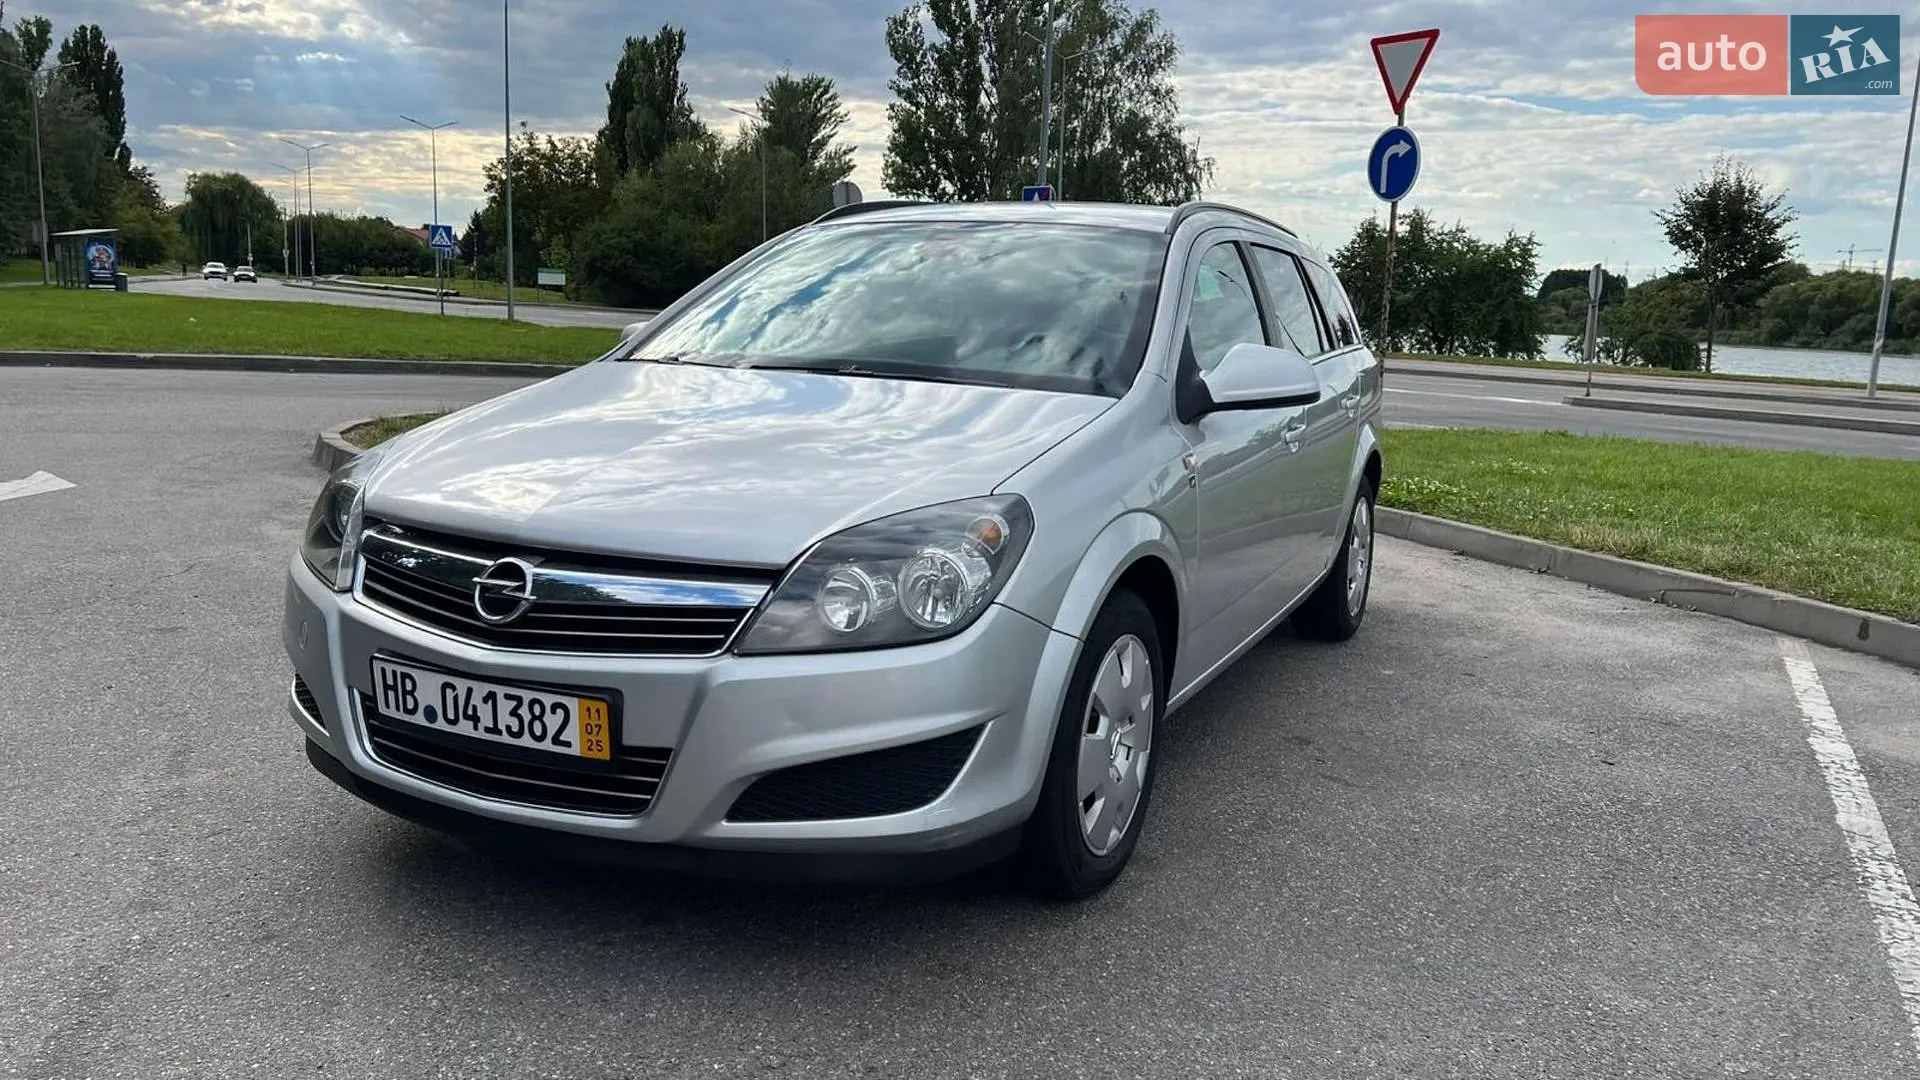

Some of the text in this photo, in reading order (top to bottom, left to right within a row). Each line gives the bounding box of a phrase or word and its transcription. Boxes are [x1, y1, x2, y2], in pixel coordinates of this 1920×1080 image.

[381, 667, 572, 748] HB 041382
[586, 707, 600, 721] 11
[586, 723, 601, 736] 07
[587, 739, 603, 752] 25
